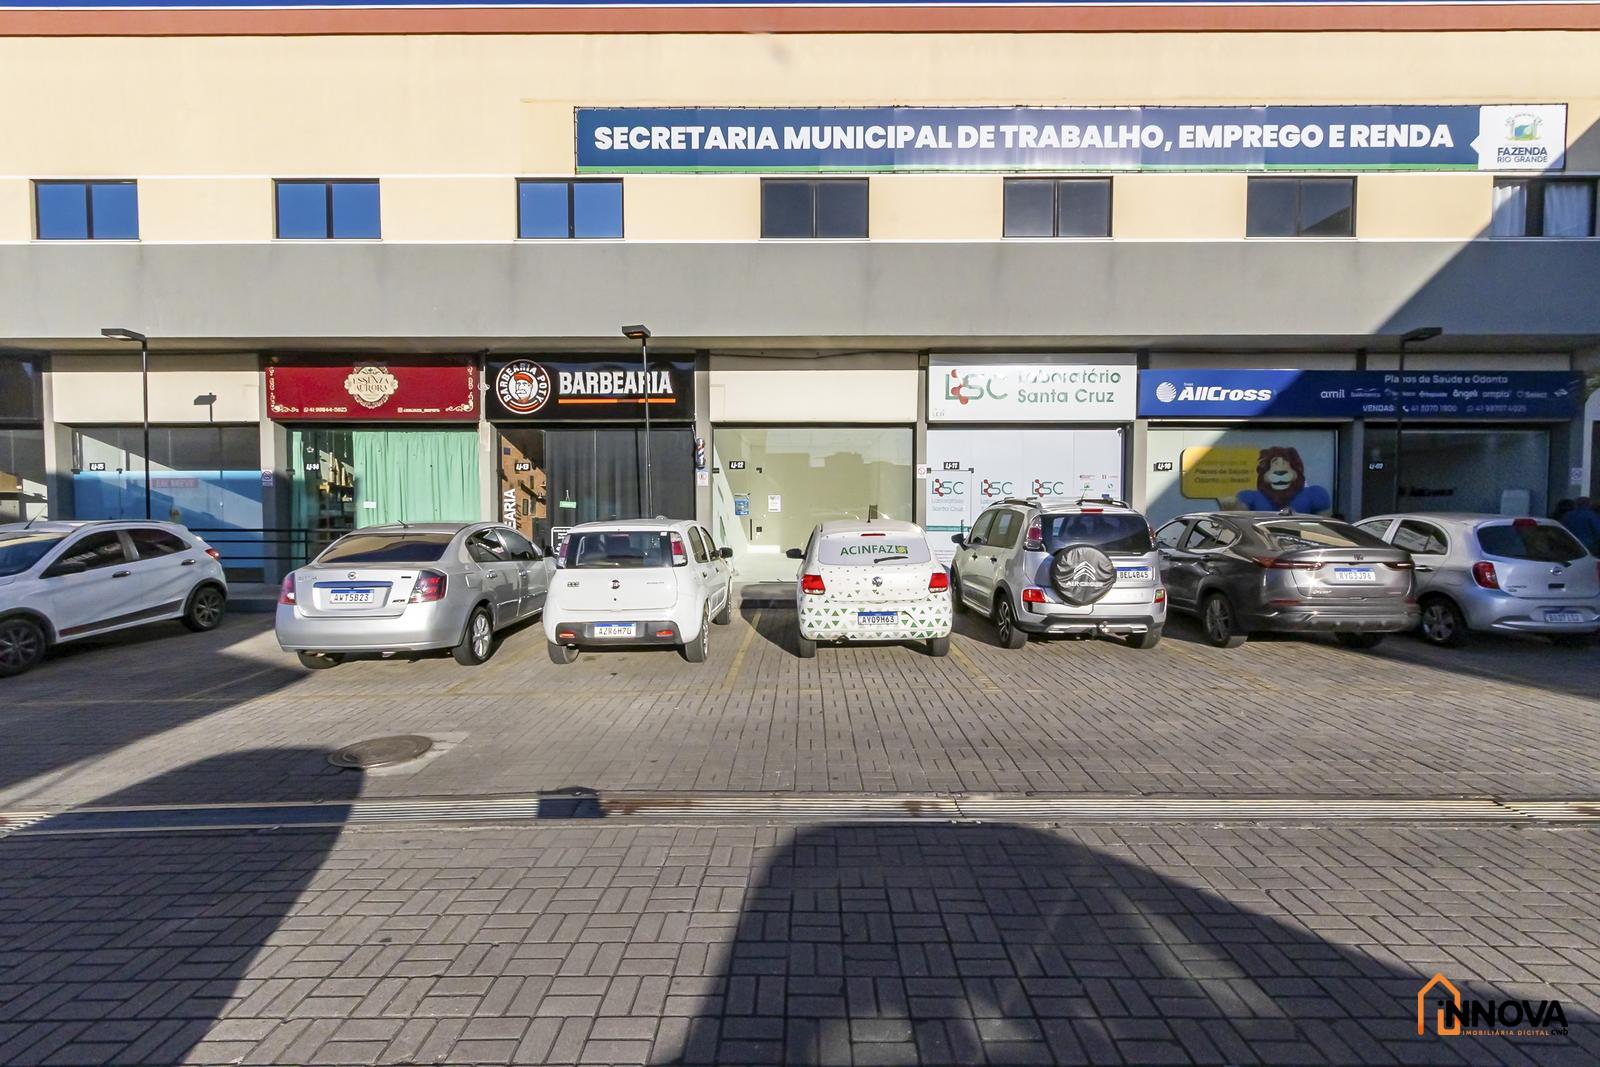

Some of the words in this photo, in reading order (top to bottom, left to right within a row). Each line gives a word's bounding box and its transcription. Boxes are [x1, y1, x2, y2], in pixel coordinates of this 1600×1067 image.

[594, 124, 774, 151] SECRETARIA
[784, 124, 952, 150] MUNICIPAL
[957, 124, 995, 149] DE
[1000, 124, 1173, 152] TRABALHO,
[1179, 124, 1324, 149] EMPREGO
[1329, 124, 1345, 148] E
[1350, 124, 1454, 148] RENDA
[1497, 147, 1548, 156] FAZENDA
[499, 361, 537, 403] BARBEARIA
[536, 374, 548, 404] POTY
[1018, 389, 1068, 403] Santa
[1075, 389, 1115, 403] Cruz
[1178, 386, 1272, 401] AllCross
[1320, 389, 1345, 399] amil
[840, 544, 892, 556] ACINFAZ
